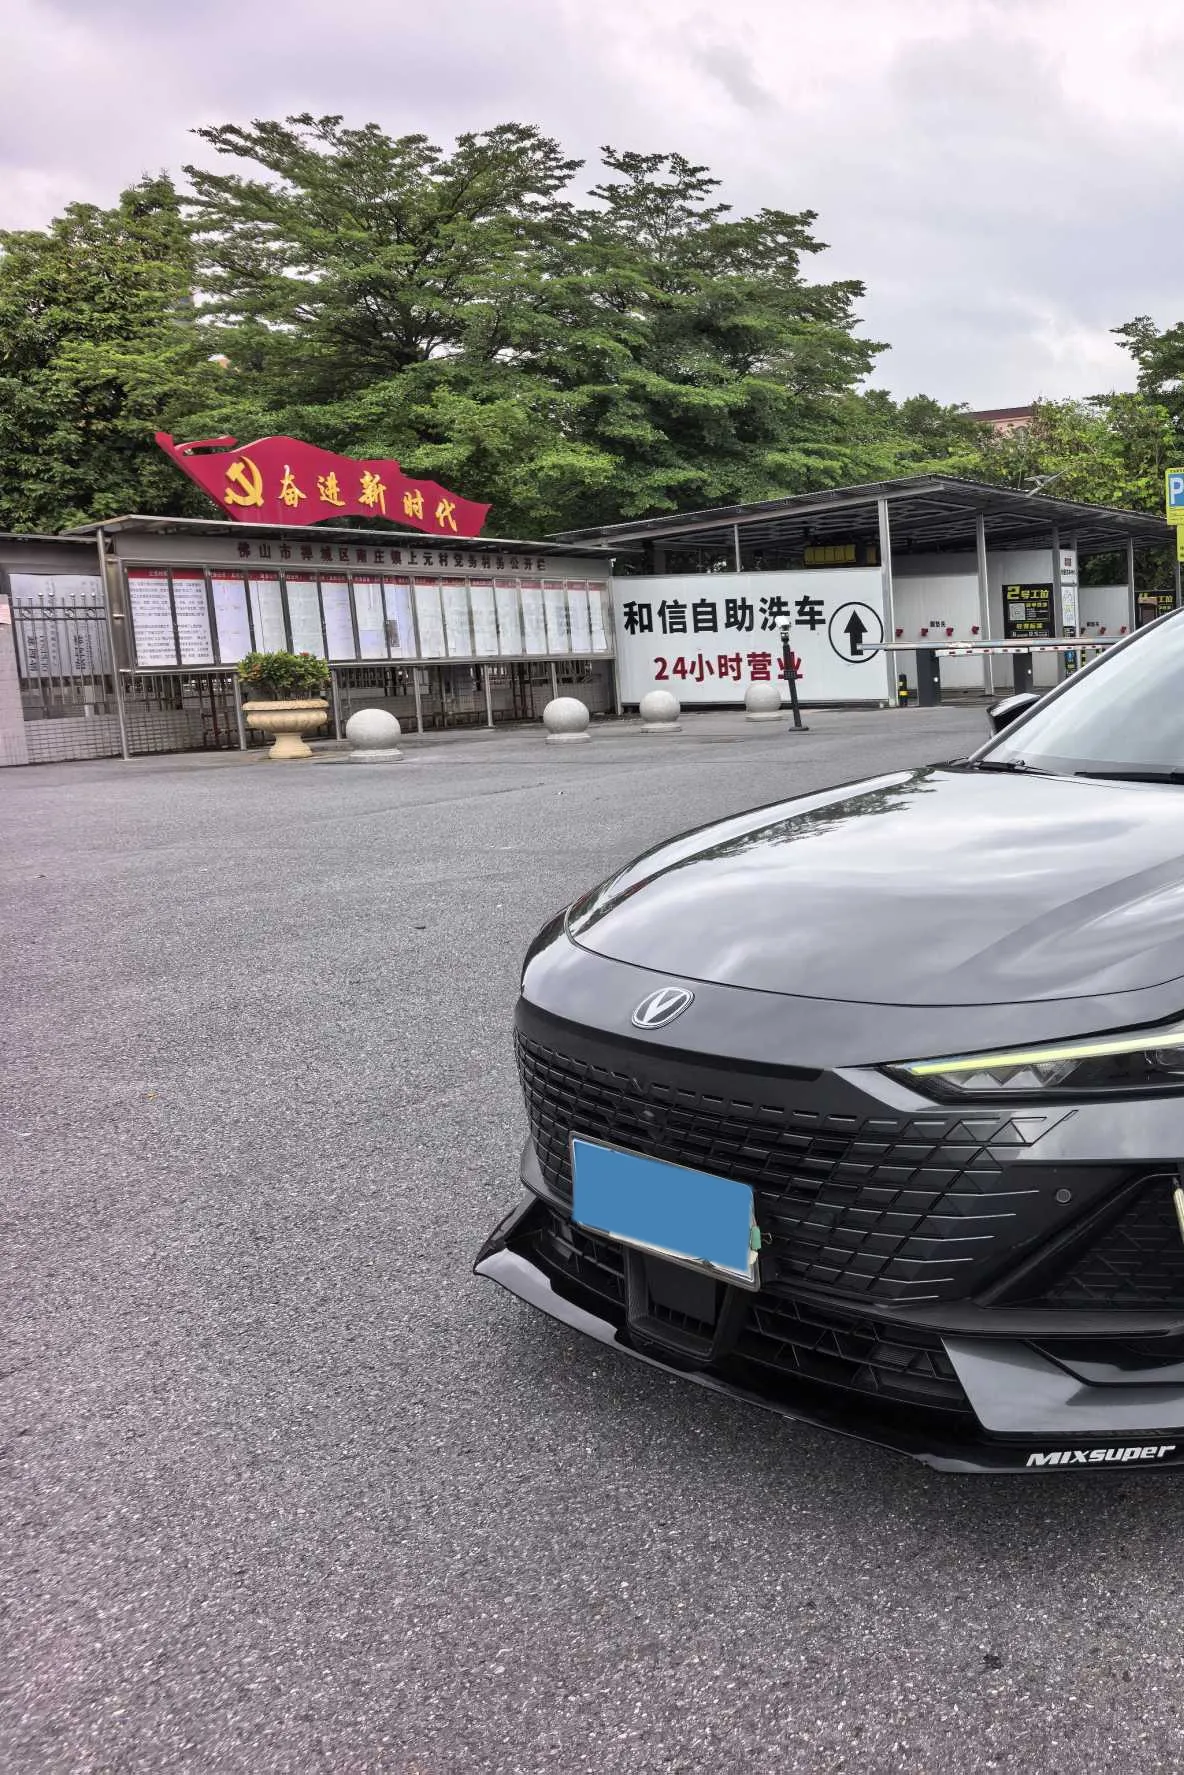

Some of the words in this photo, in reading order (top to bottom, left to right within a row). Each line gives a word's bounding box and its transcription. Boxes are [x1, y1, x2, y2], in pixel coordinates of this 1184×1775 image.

[277, 464, 458, 532] 奋进新时代
[623, 595, 826, 635] 和信自助洗车
[654, 651, 803, 682] 24小时营业
